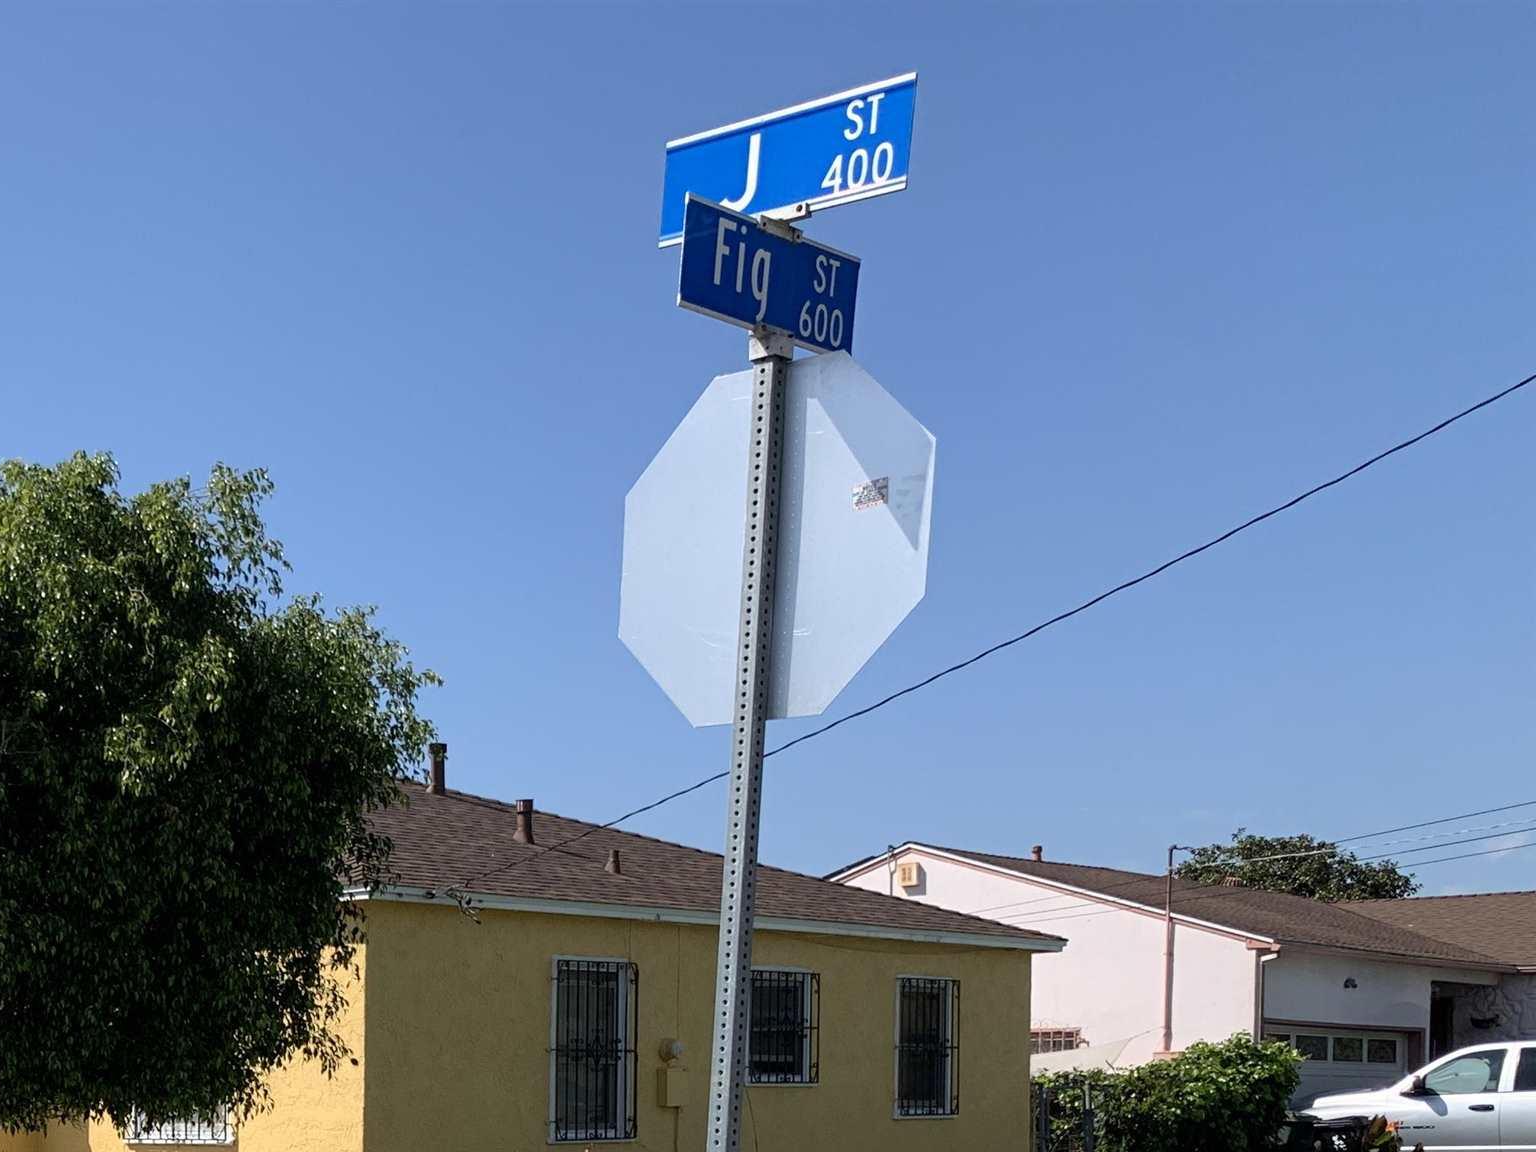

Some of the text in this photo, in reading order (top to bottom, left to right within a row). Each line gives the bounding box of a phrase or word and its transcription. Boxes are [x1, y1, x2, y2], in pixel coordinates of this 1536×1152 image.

[719, 92, 886, 213] J ST
[820, 141, 894, 195] 400
[713, 217, 841, 322] Fig ST
[798, 299, 844, 348] 600
